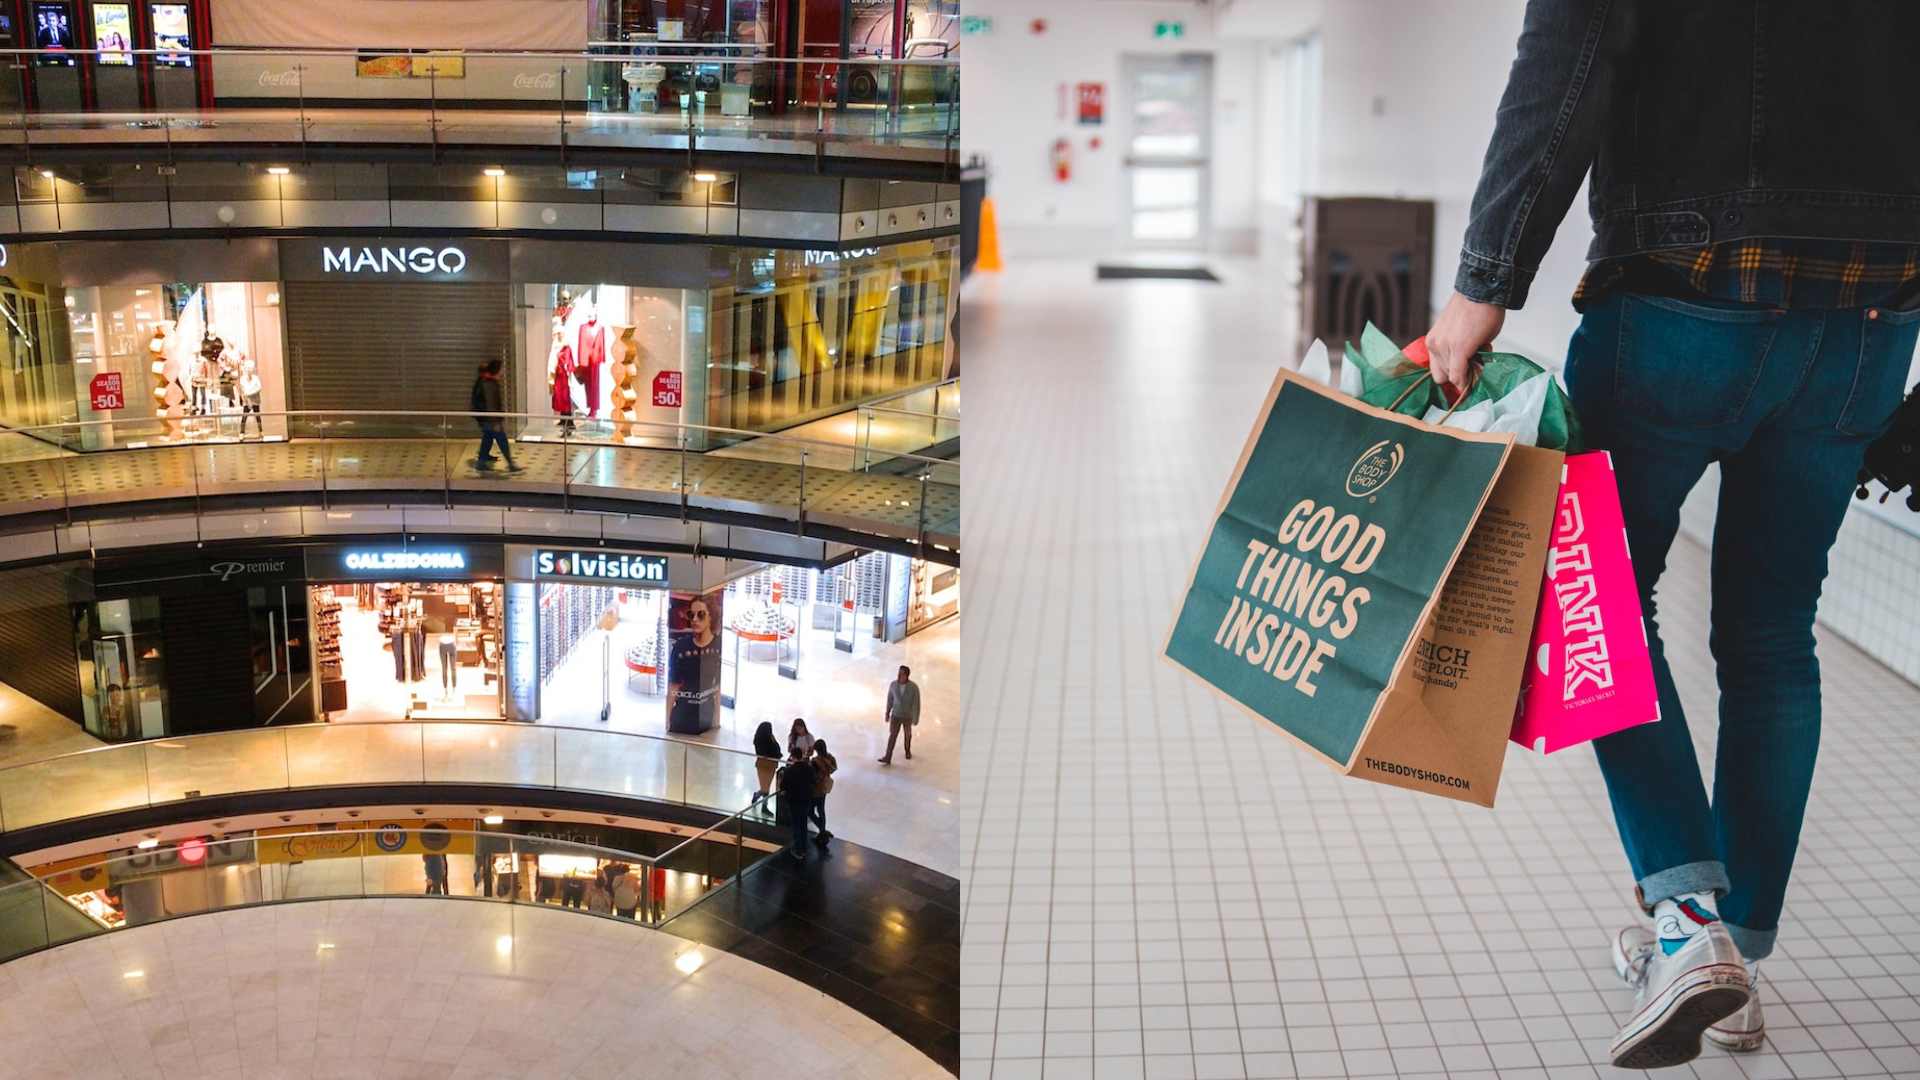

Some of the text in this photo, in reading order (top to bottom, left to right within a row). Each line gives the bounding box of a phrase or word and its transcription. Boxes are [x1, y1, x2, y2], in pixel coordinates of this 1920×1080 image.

[322, 247, 466, 273] MANGO
[1370, 456, 1388, 468] THE
[1358, 464, 1387, 479] BODY
[1351, 474, 1377, 488] SHOP
[1277, 499, 1386, 574] GOOD
[1497, 525, 1508, 535] for
[1483, 534, 1495, 543] the
[1498, 538, 1524, 548] mould
[1476, 552, 1495, 563] than
[1484, 545, 1508, 556] Today
[1511, 550, 1525, 558] our
[345, 552, 465, 569] CALZEDONIA
[539, 552, 663, 580] Solvisión
[1468, 560, 1480, 569] the
[210, 559, 286, 581] Premier
[1468, 571, 1500, 584] farmers
[1503, 576, 1519, 587] and
[1236, 538, 1371, 639] THINGS
[1461, 580, 1513, 596] communities
[1452, 597, 1468, 607] and
[1470, 601, 1484, 609] are
[1487, 605, 1511, 614] never
[1492, 596, 1516, 606] never
[1450, 607, 1464, 615] are
[1467, 609, 1491, 620] proud
[1494, 614, 1502, 623] to
[1505, 616, 1514, 625] be
[1439, 625, 1454, 633] can
[1456, 626, 1466, 635] do
[1448, 615, 1460, 626] for
[1463, 618, 1489, 630] what's
[1492, 623, 1515, 635] right.
[1214, 595, 1337, 698] INSIDE
[1595, 690, 1616, 701] SECRET
[1365, 757, 1470, 790] THEBODYSHOP.COM
